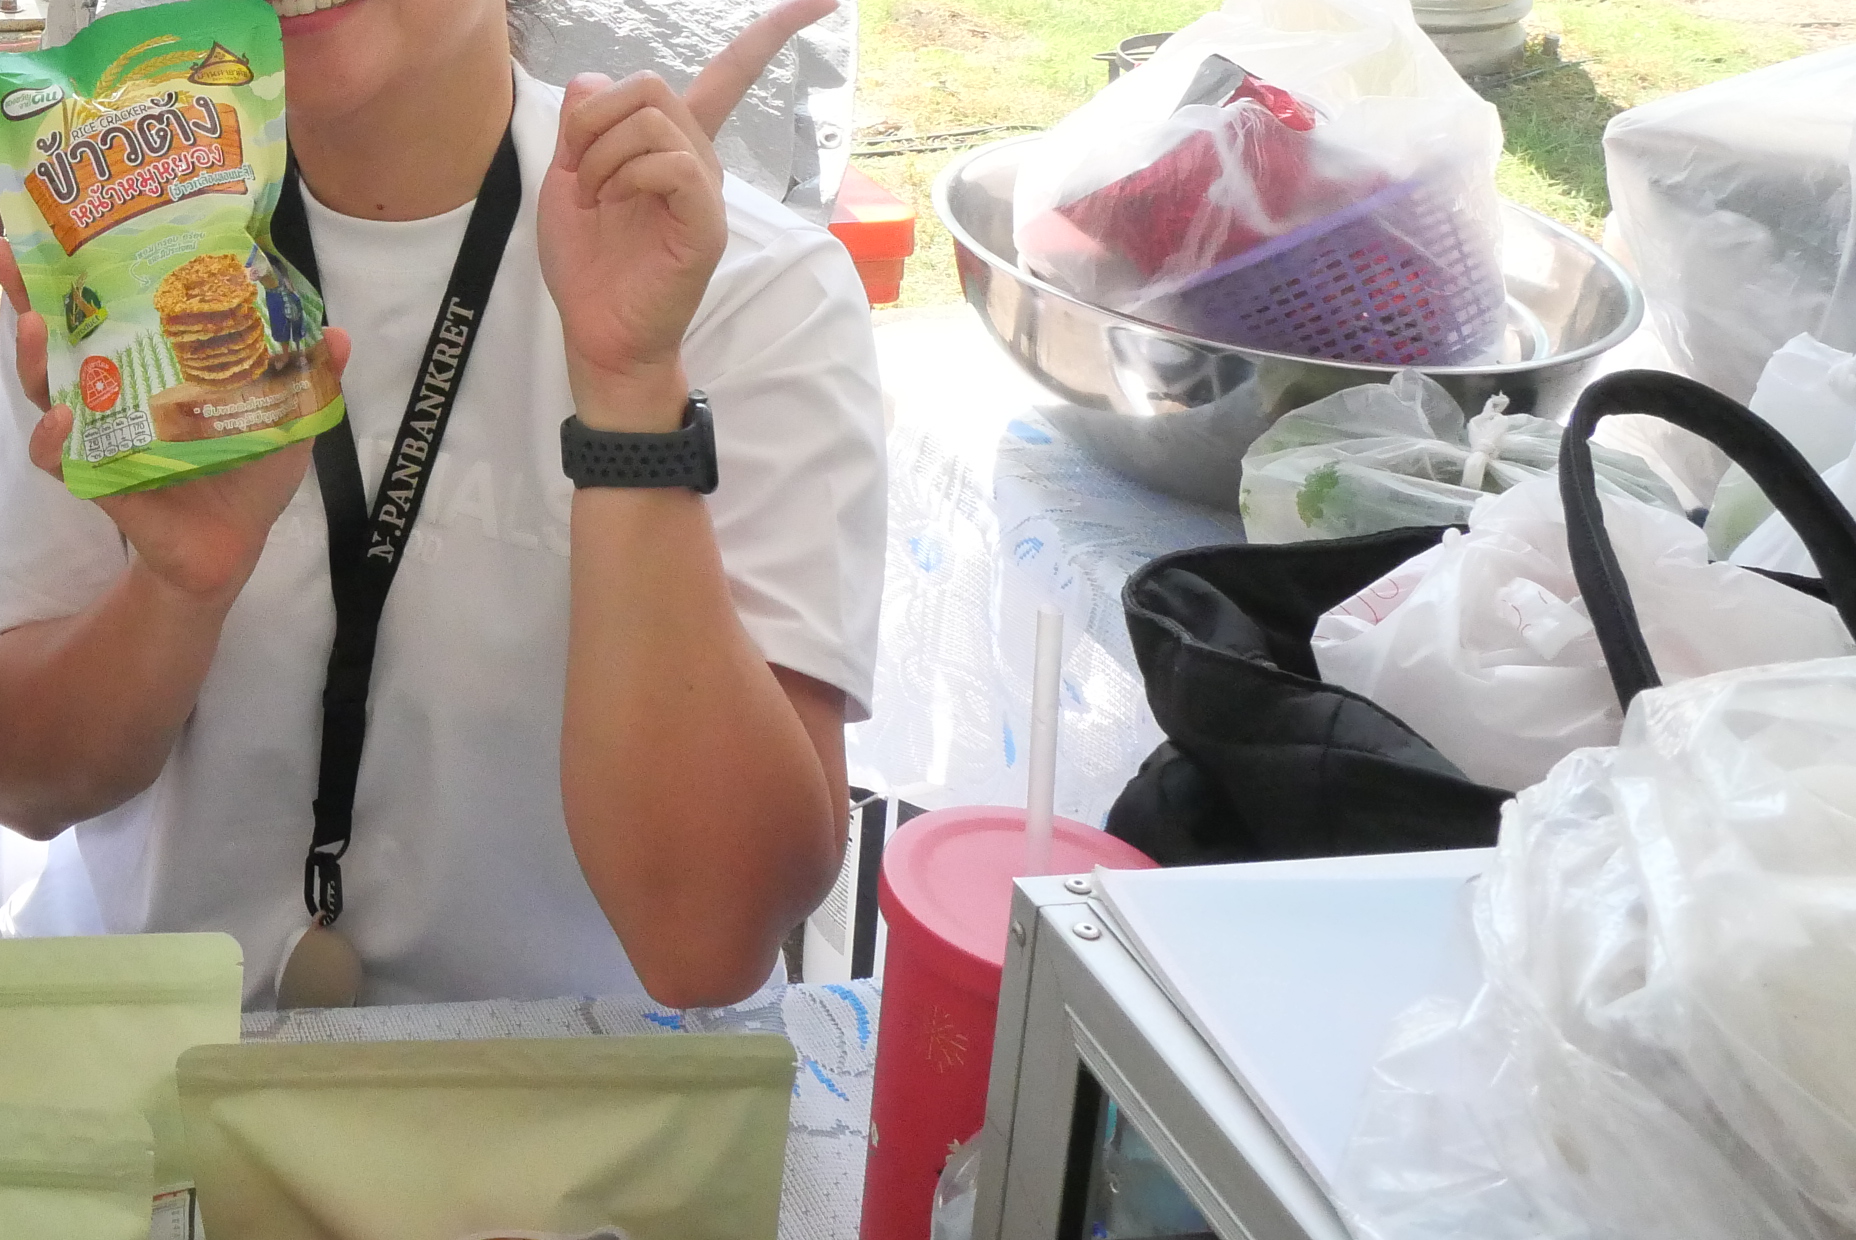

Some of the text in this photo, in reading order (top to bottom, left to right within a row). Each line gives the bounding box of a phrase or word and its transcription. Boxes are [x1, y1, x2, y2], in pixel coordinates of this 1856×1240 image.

[71, 103, 149, 142] RICE CRACKER
[69, 143, 224, 228] หน้าหมูหยอง
